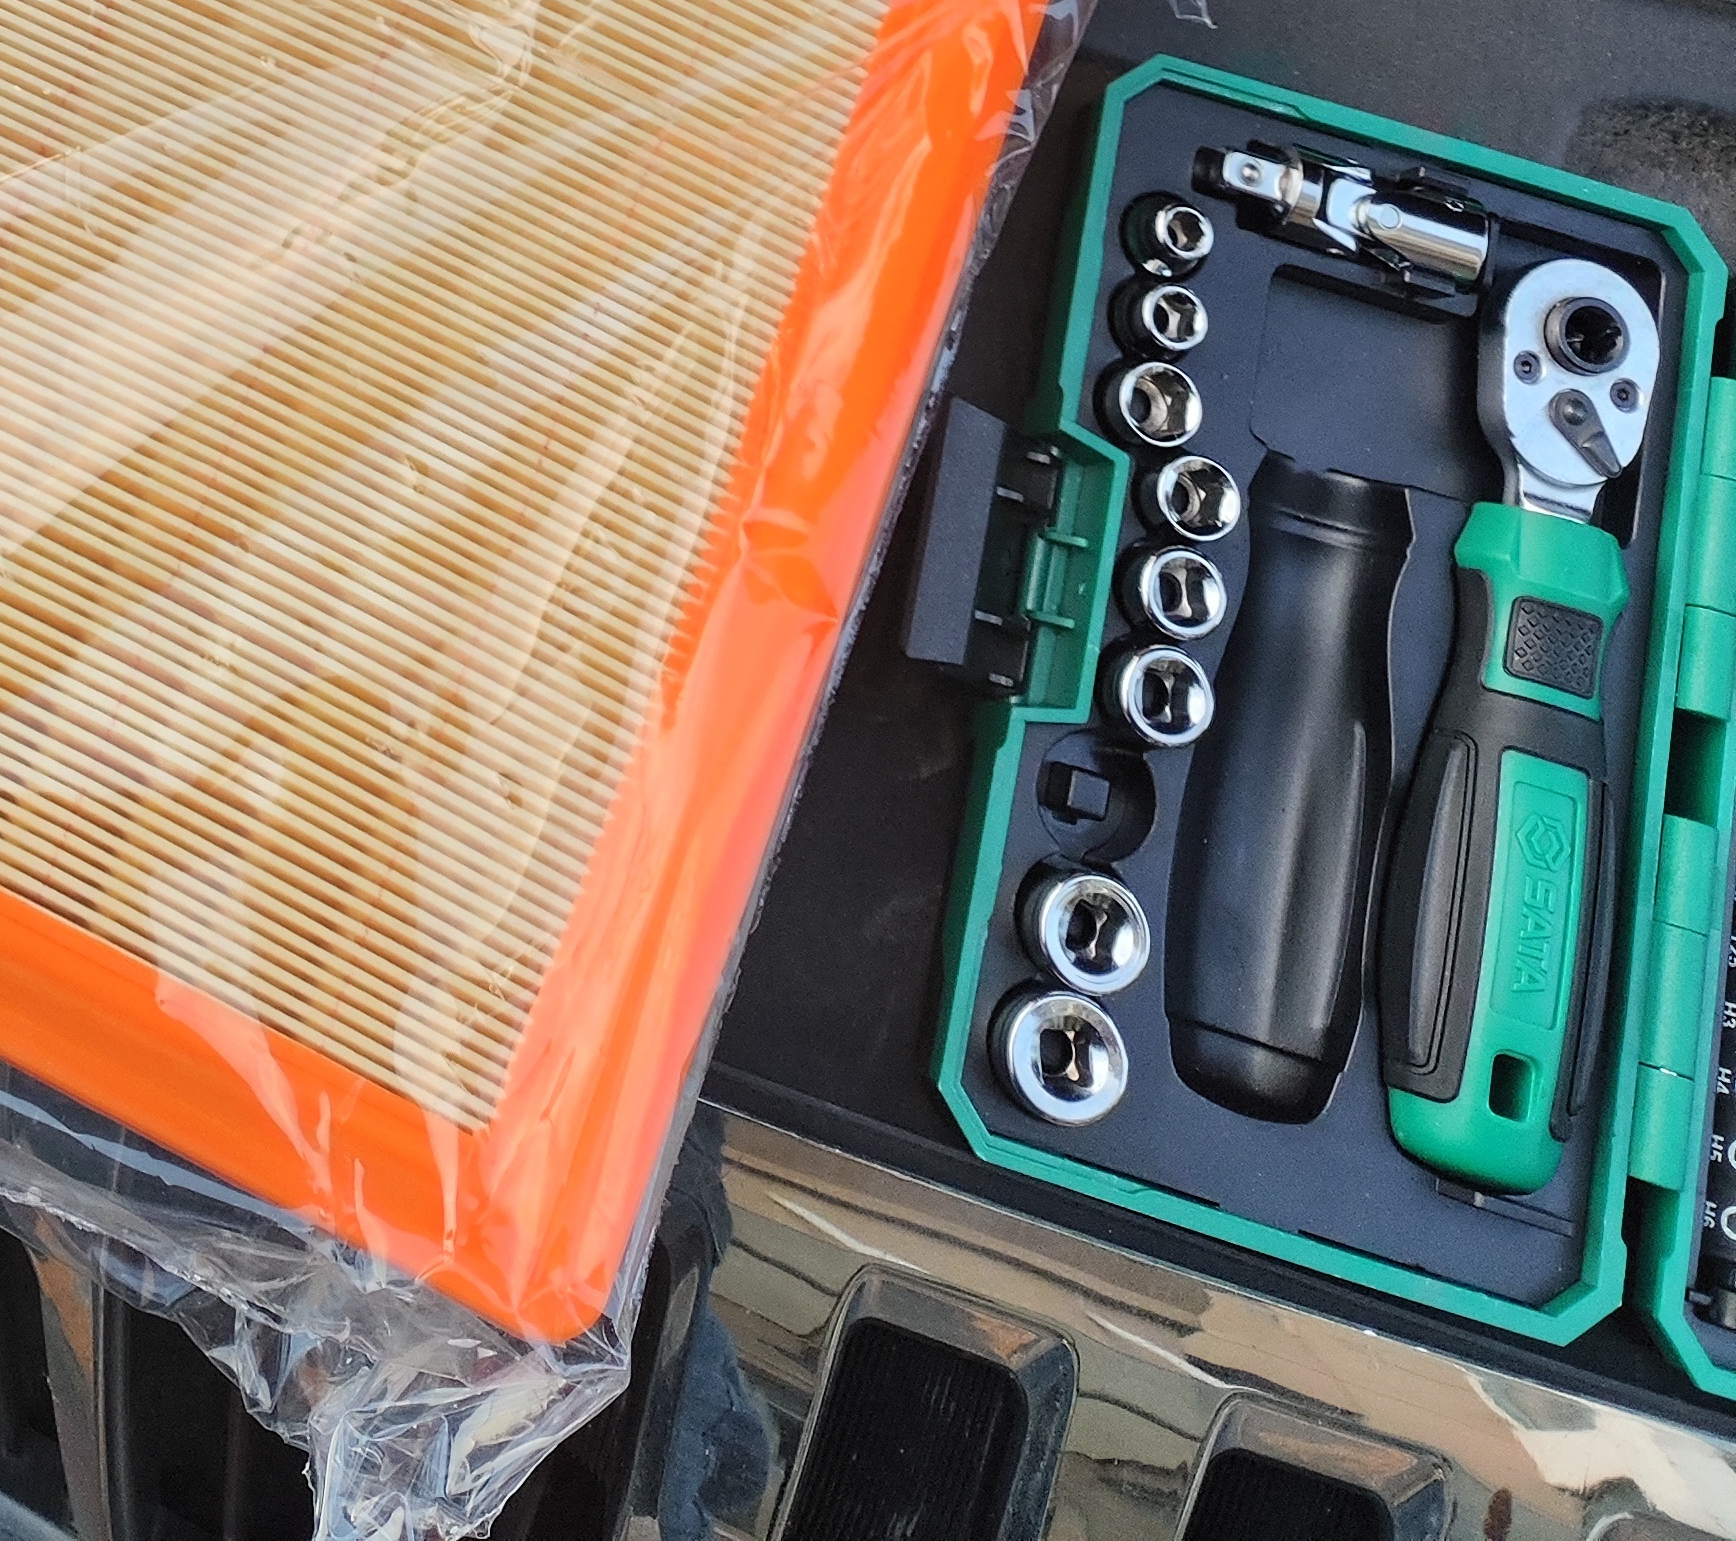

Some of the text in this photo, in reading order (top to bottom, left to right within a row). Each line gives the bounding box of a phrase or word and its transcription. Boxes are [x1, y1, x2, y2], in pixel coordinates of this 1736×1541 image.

[1510, 874, 1560, 995] SATA
[1716, 1066, 1732, 1094] H4
[1710, 1134, 1725, 1162] H5
[1703, 1200, 1718, 1228] H6
